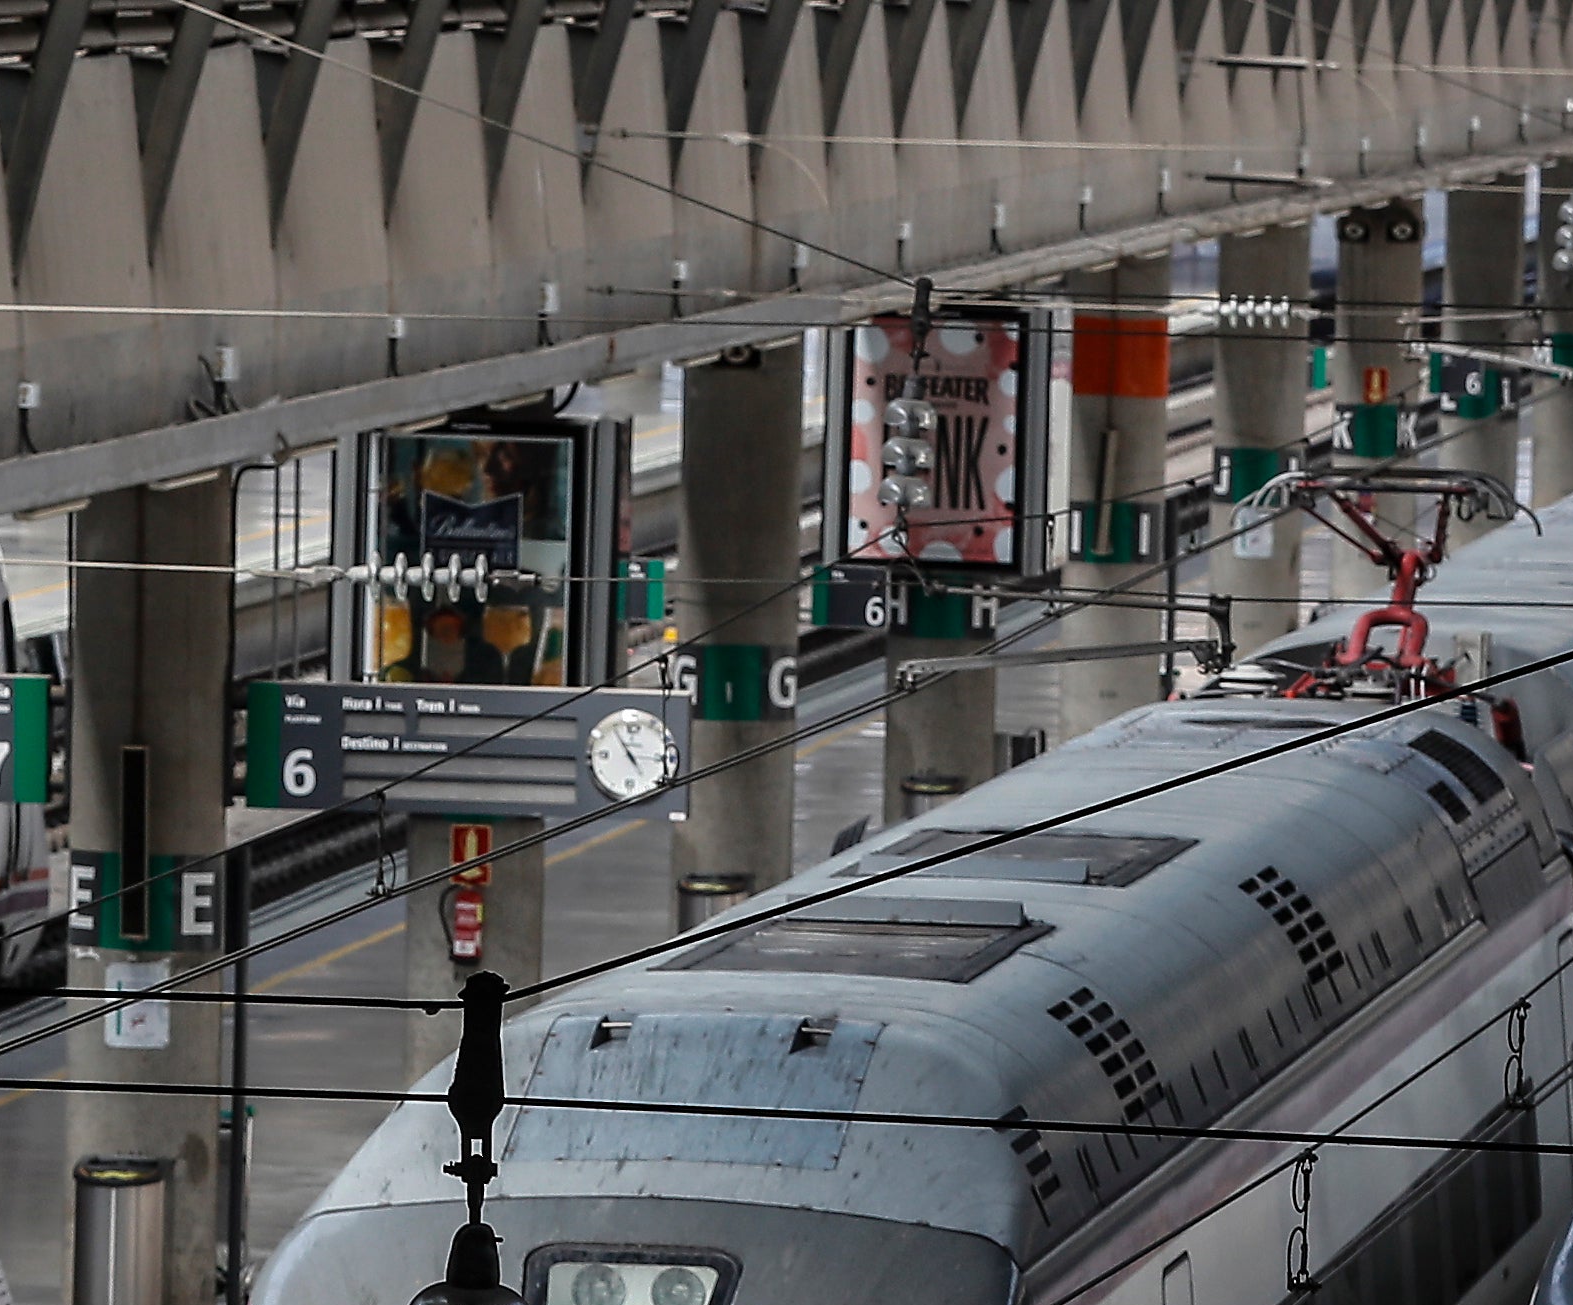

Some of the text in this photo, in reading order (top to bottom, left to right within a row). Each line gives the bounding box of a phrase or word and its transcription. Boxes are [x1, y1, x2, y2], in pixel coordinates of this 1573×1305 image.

[1464, 372, 1483, 396] 6
[1332, 410, 1354, 450] K
[1397, 411, 1419, 450] K
[864, 595, 885, 627] 6
[971, 583, 999, 629] H
[768, 656, 798, 709] G
[282, 747, 318, 798] 6
[69, 864, 96, 931] E
[180, 871, 215, 936] E
